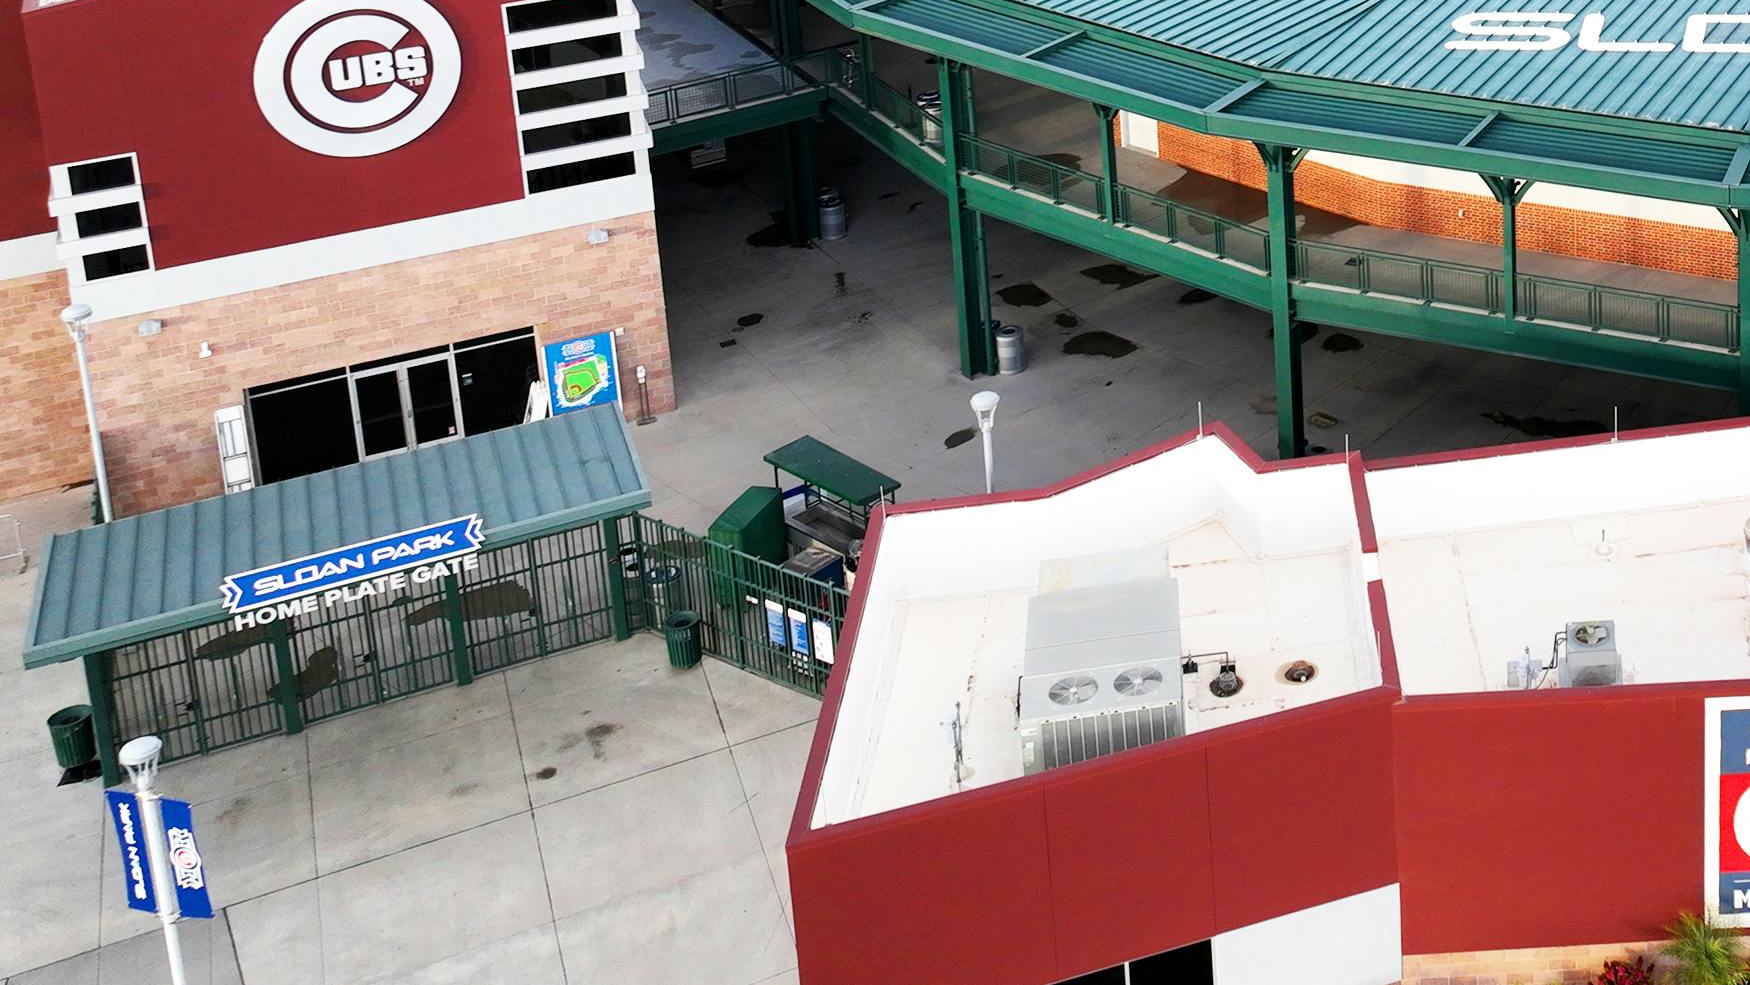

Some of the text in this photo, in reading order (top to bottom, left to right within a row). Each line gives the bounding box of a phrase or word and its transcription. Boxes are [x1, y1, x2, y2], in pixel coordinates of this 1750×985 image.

[290, 14, 429, 129] CUBS
[233, 552, 480, 632] HOME PLATE GATE
[252, 529, 456, 597] SLOAN PARK
[118, 802, 147, 900] SLOAN PARK
